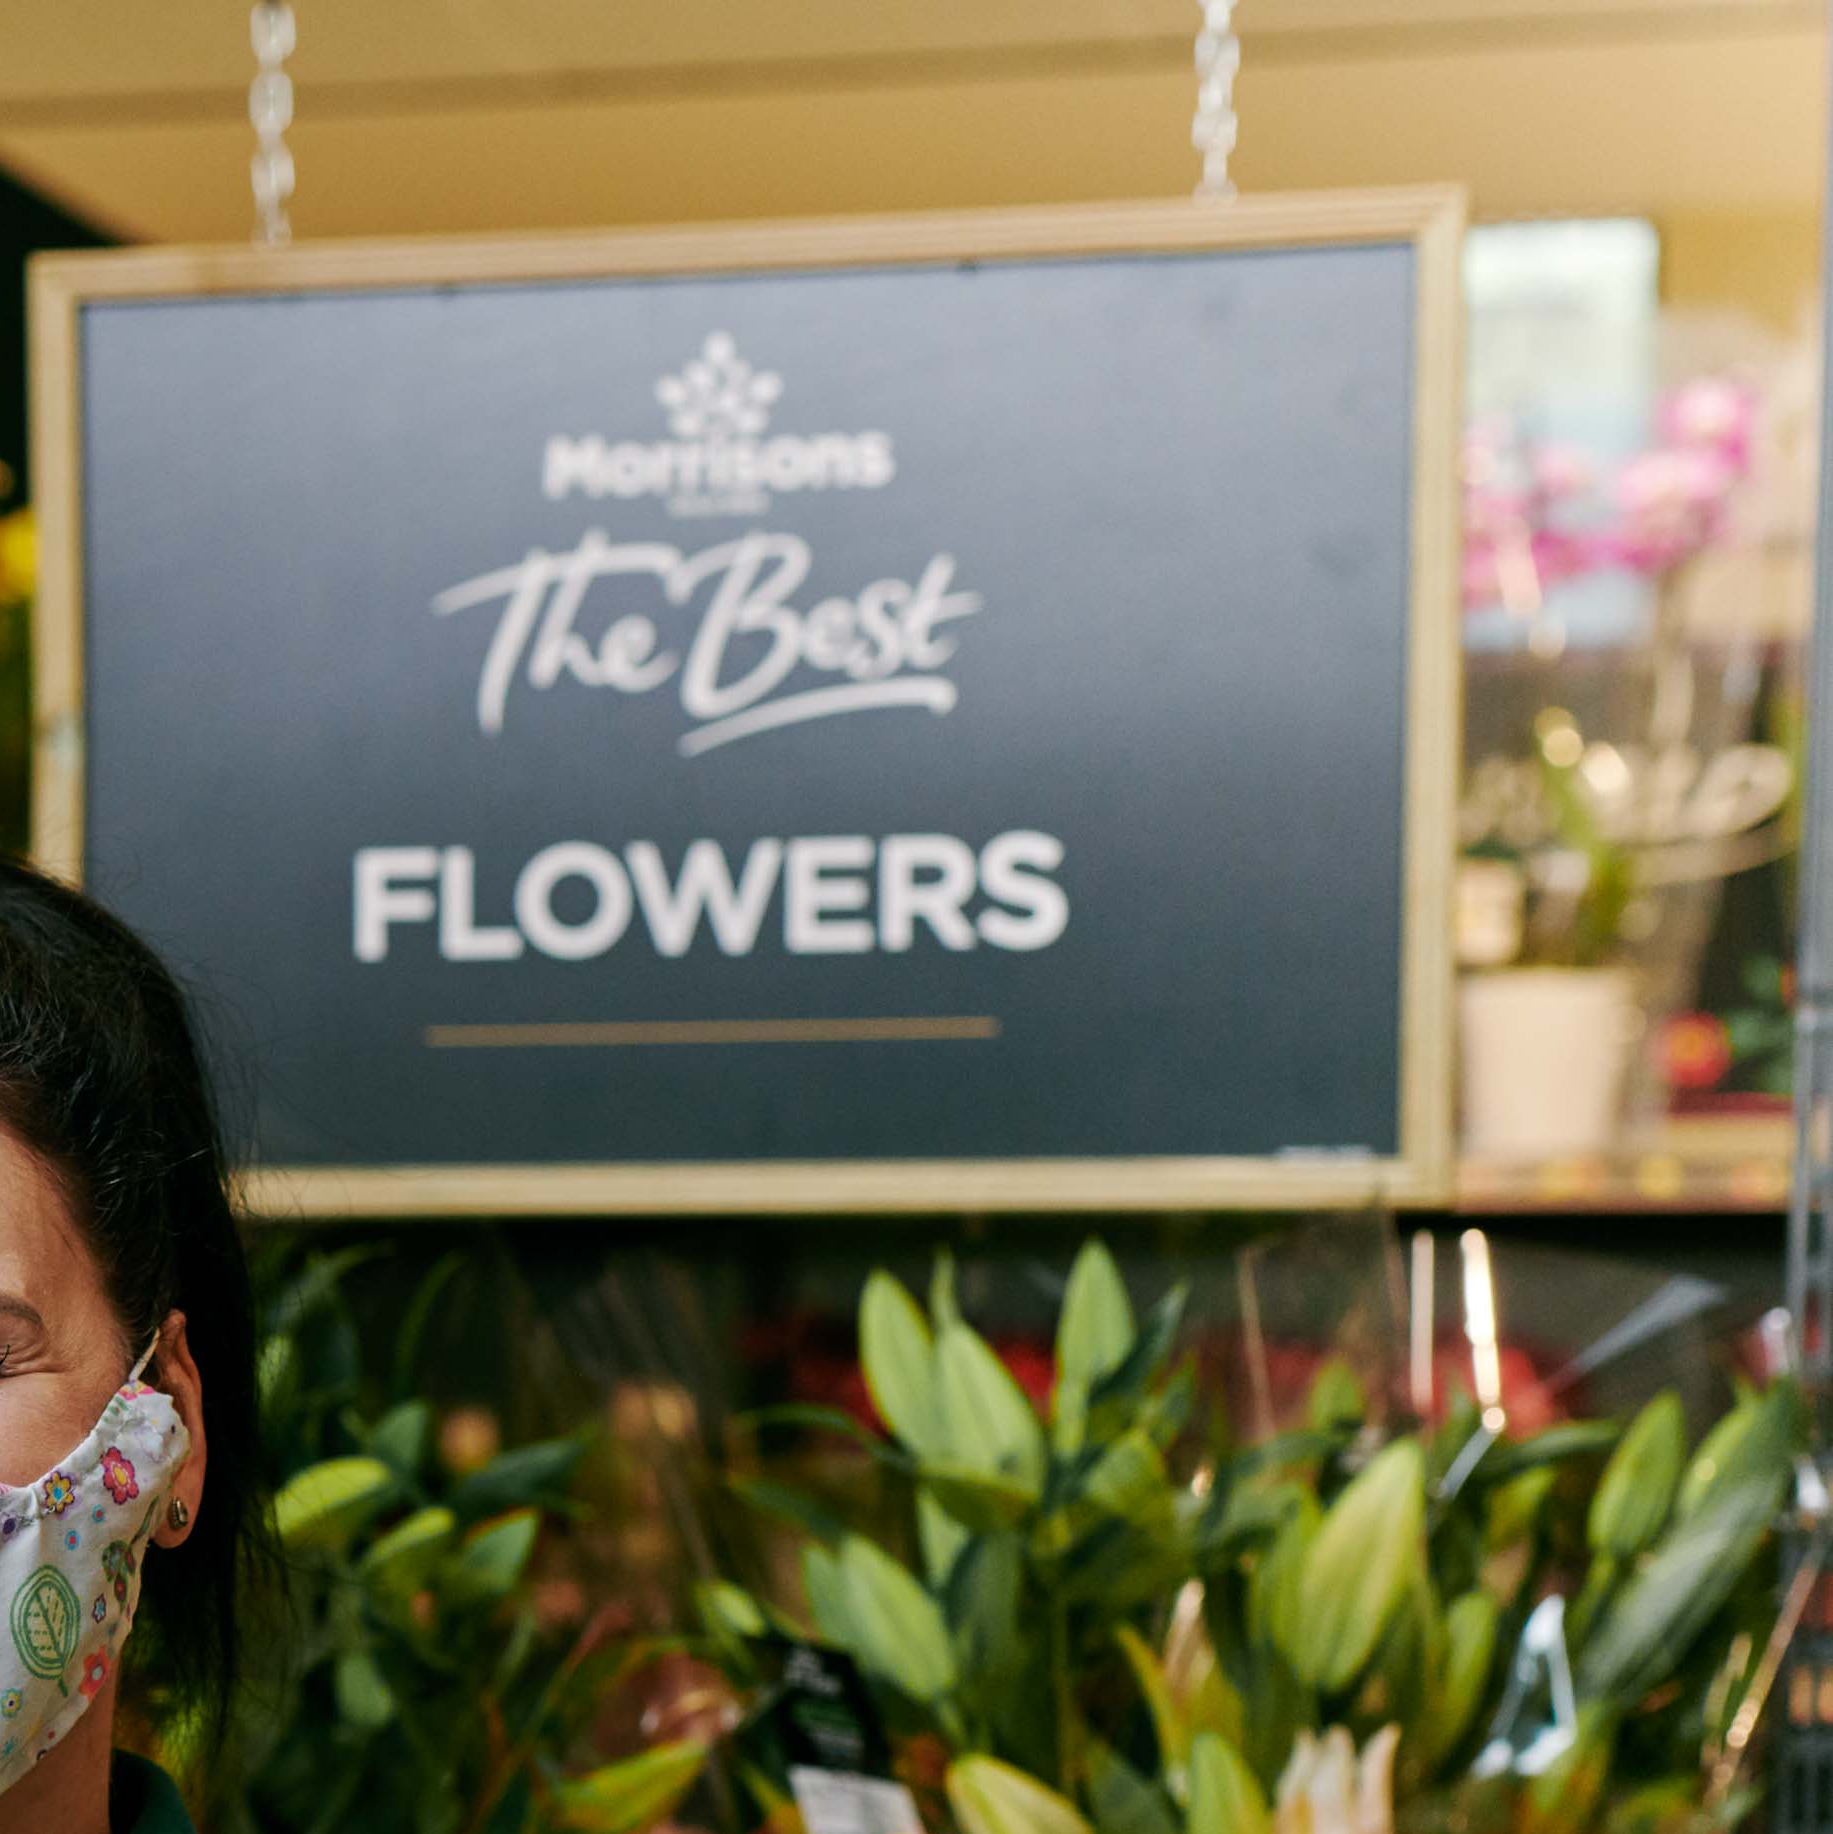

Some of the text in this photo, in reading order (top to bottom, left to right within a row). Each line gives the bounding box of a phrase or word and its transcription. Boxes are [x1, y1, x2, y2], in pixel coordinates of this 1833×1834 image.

[543, 431, 896, 500] Morrisons
[430, 527, 981, 737] The Best
[351, 828, 1069, 963] FLOWERS
